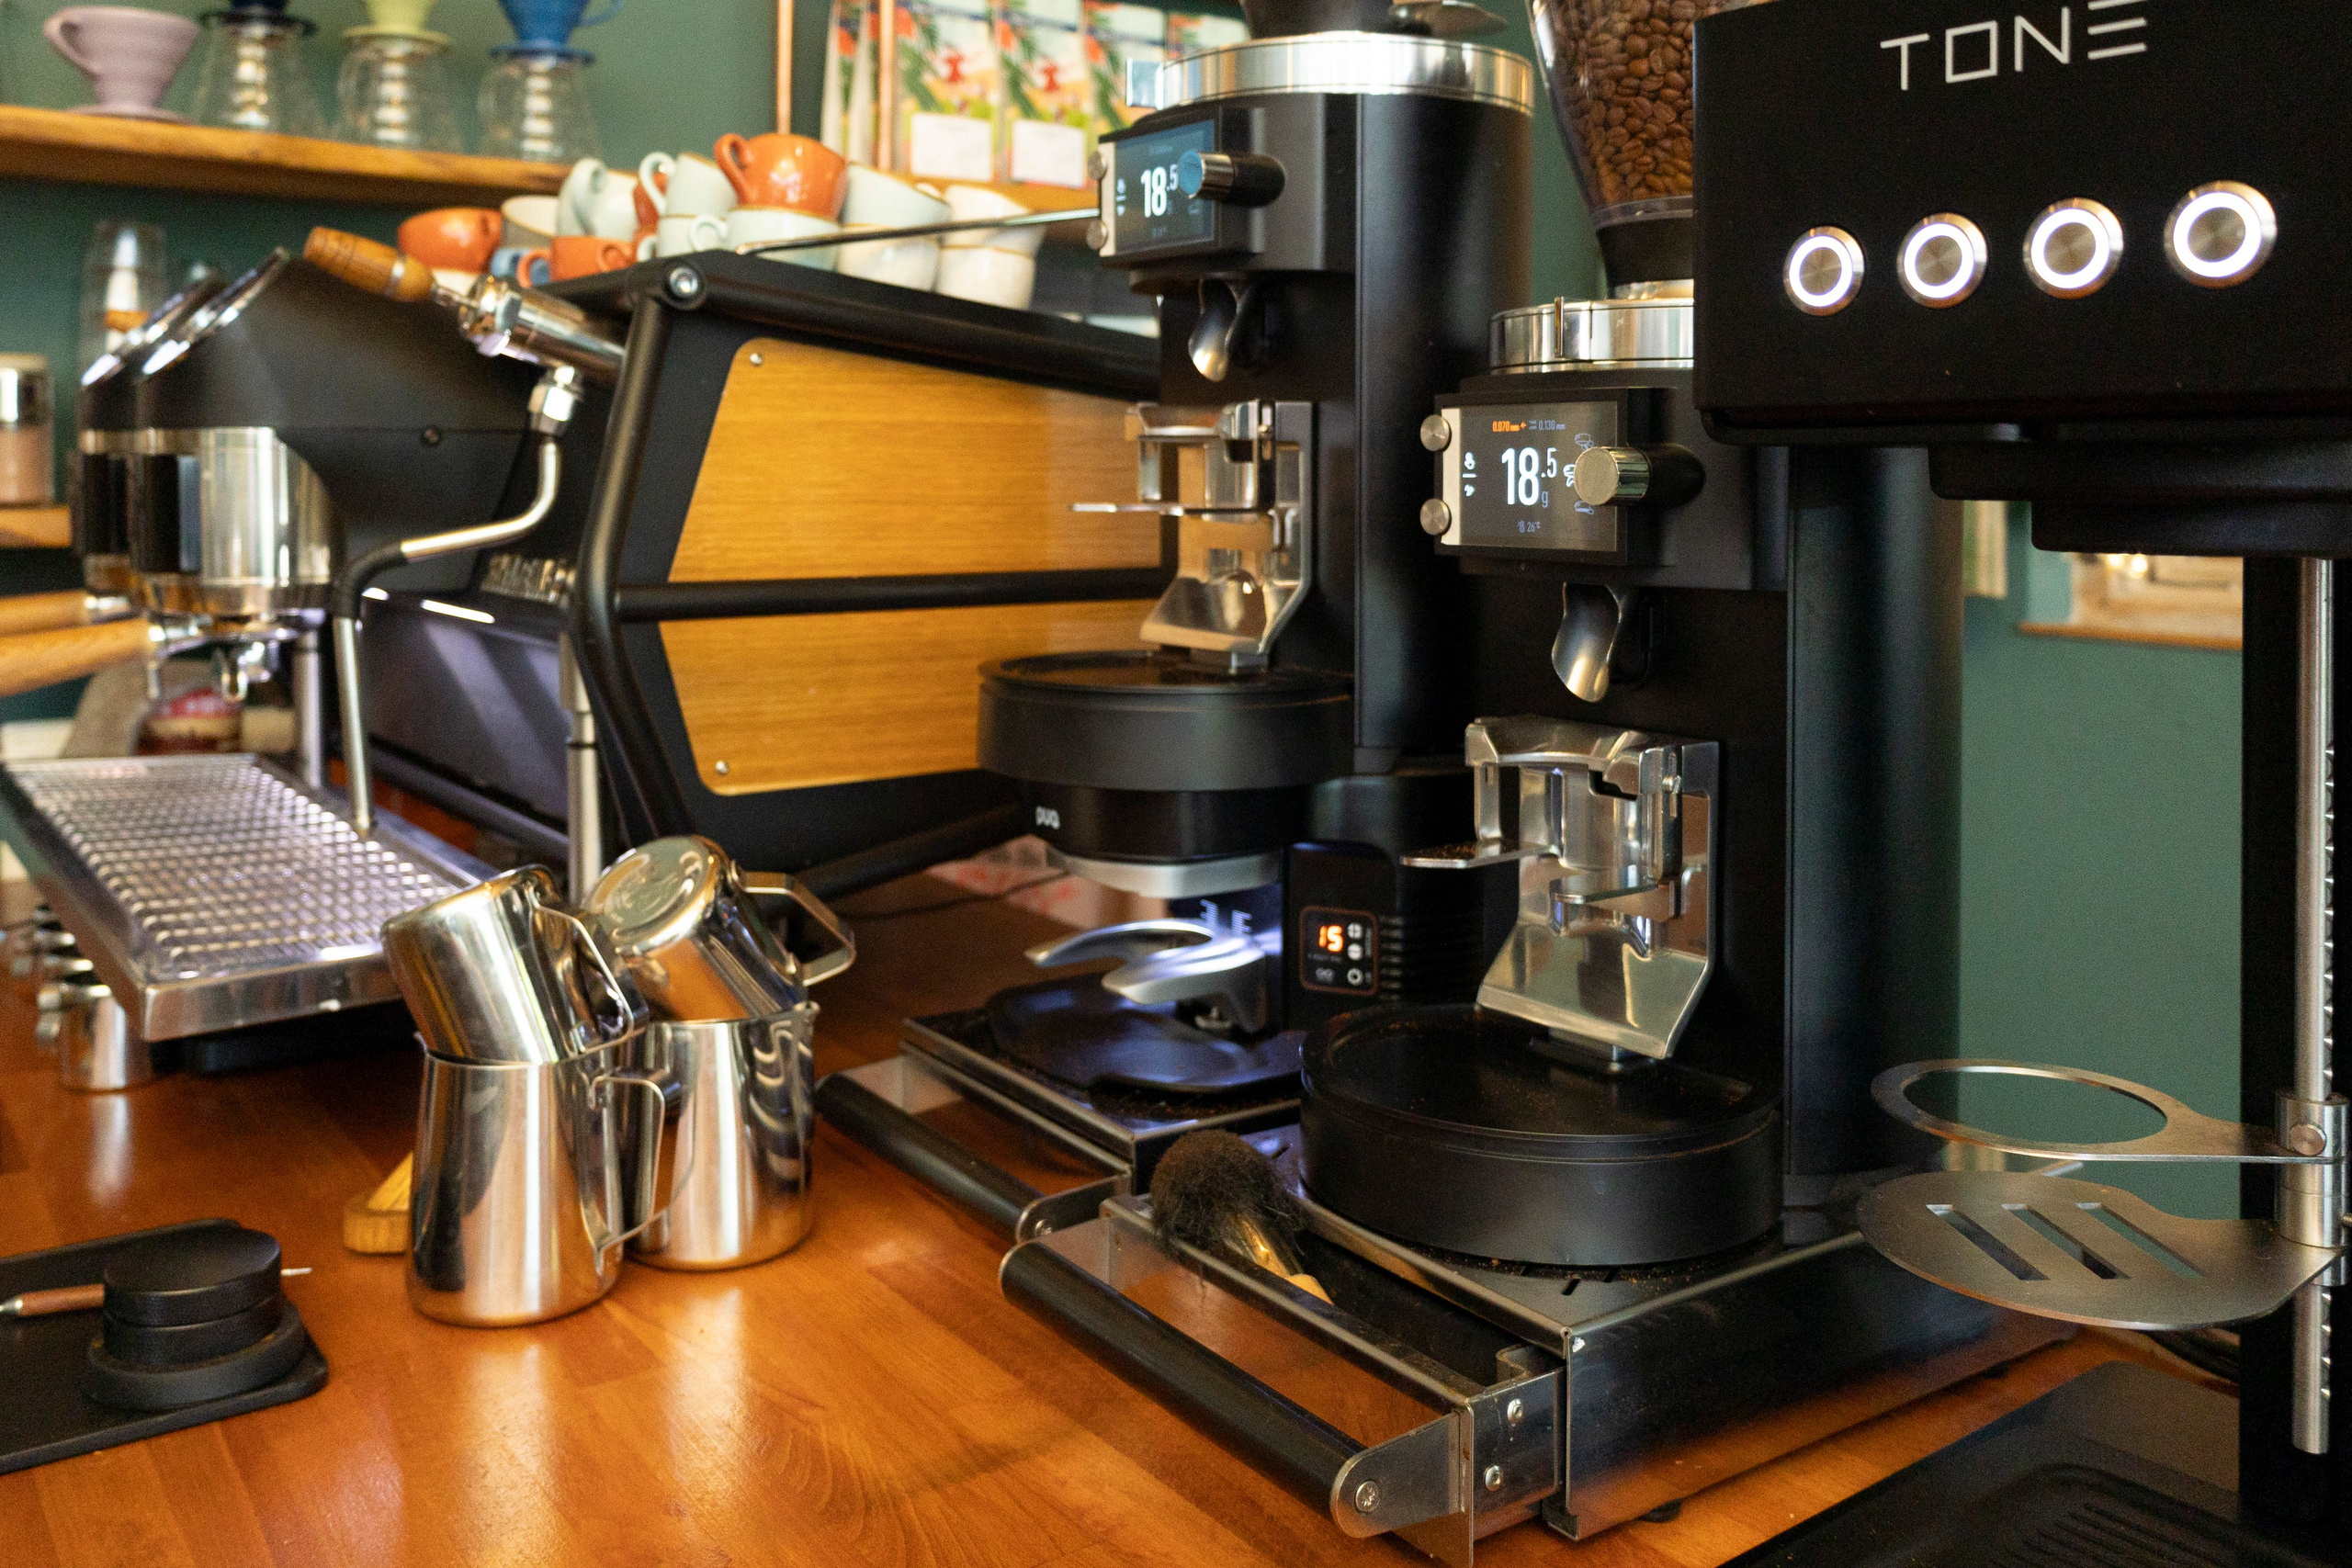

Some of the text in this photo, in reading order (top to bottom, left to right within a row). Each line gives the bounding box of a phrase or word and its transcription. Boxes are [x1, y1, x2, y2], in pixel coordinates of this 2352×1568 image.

[1880, 0, 2148, 91] TONE
[1501, 446, 1557, 506] 18.5
[1318, 925, 1343, 953] 15
